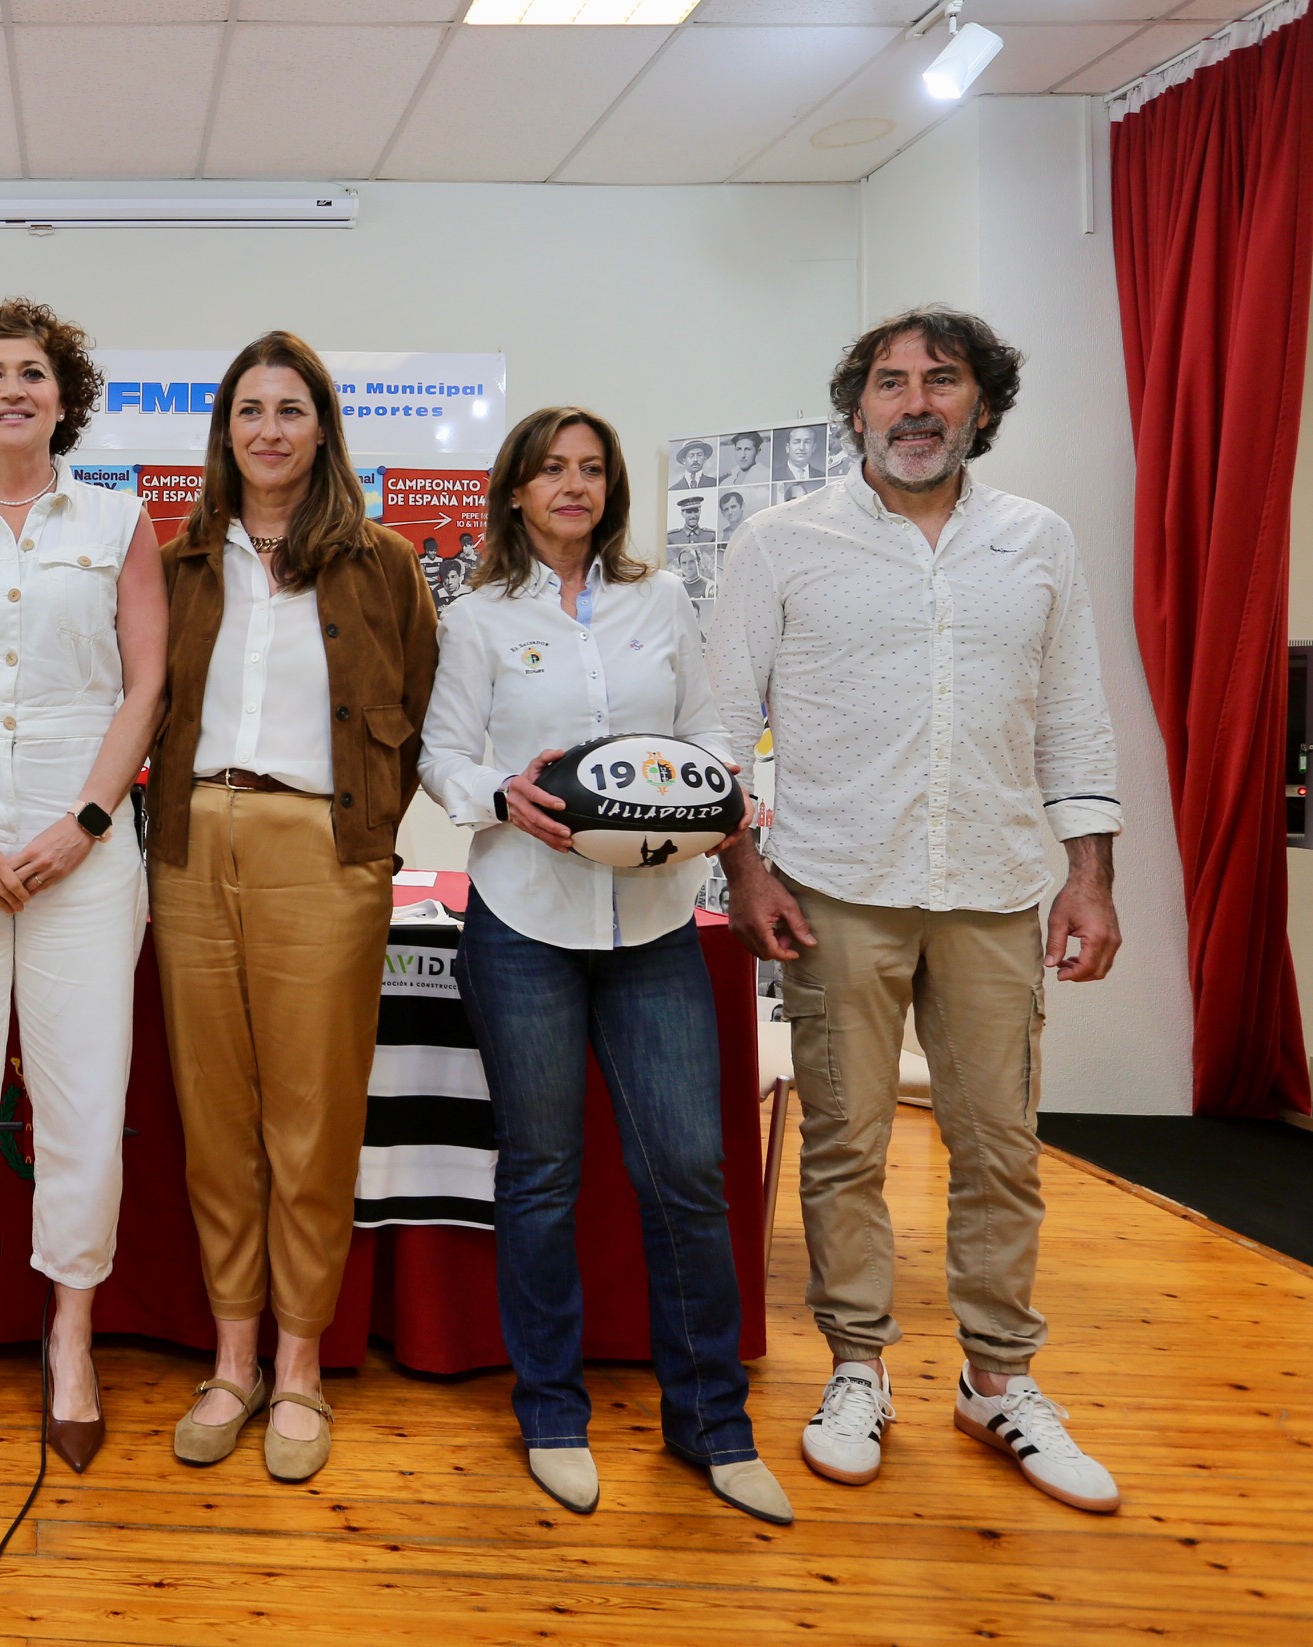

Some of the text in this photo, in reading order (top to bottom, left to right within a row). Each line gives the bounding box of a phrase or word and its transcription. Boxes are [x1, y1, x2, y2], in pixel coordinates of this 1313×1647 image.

[366, 382, 483, 397] Municipal
[105, 381, 221, 415] FMD
[342, 405, 443, 418] eportes
[74, 469, 130, 481] Nacional
[388, 478, 481, 492] CAMPEONATO
[142, 490, 159, 502] DE
[388, 492, 486, 507] DE ESPAÑA M14
[461, 512, 480, 520] PEPE
[590, 761, 636, 791] 19
[680, 762, 726, 793] 60
[597, 799, 723, 819] VALLADOLID
